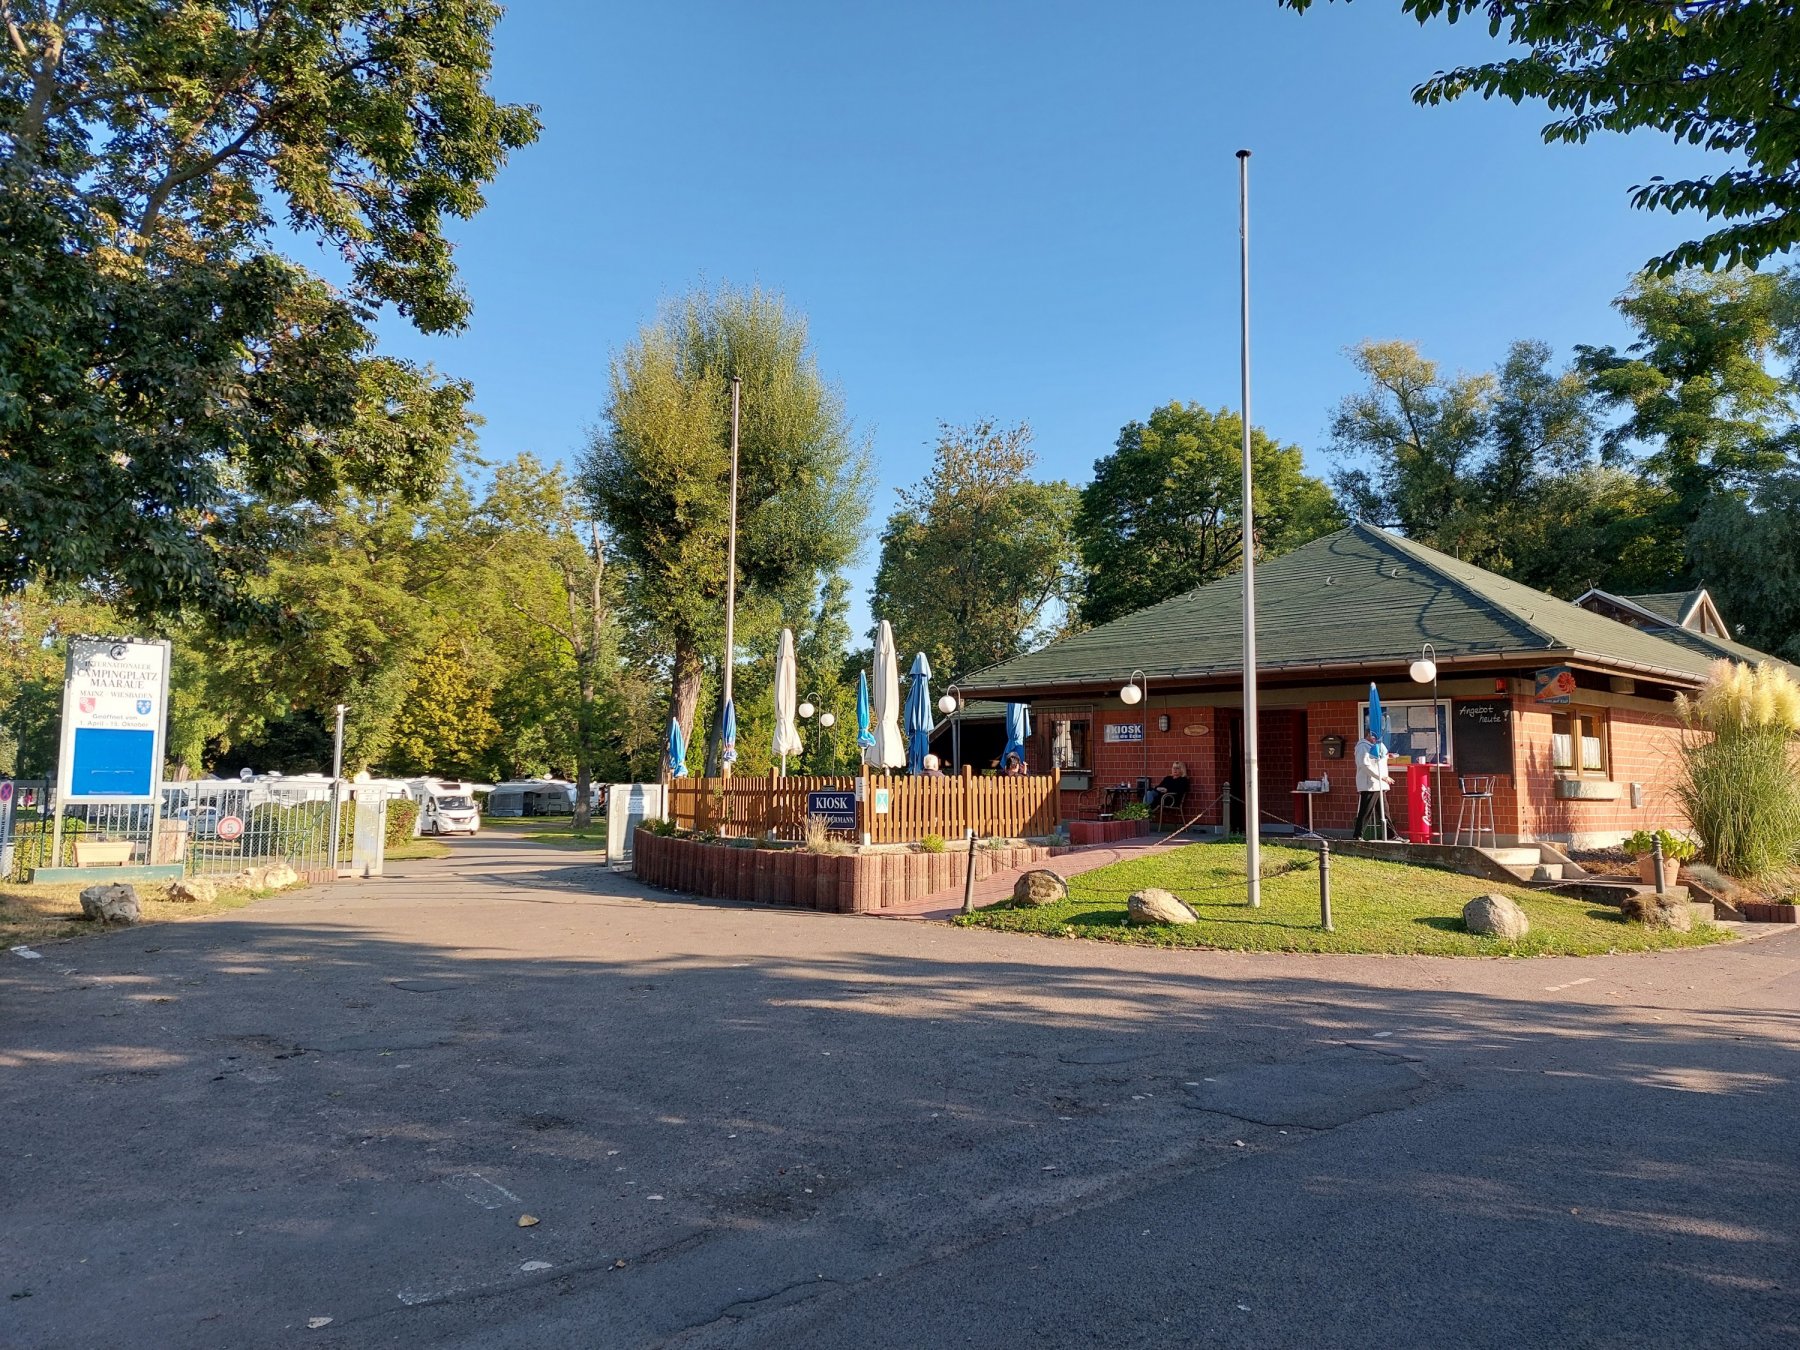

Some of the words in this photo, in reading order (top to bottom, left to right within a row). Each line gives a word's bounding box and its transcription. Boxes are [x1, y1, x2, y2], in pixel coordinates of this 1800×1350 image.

[85, 660, 151, 670] INTERNATIONALER
[77, 669, 158, 681] CAMPINGPLATZ
[90, 679, 144, 689] MAARAUE
[110, 691, 153, 699] WIESBADEN
[1459, 704, 1494, 717] Angebot
[1111, 725, 1142, 734] KIOSK
[815, 797, 848, 809] KIOSK
[227, 823, 234, 833] 5
